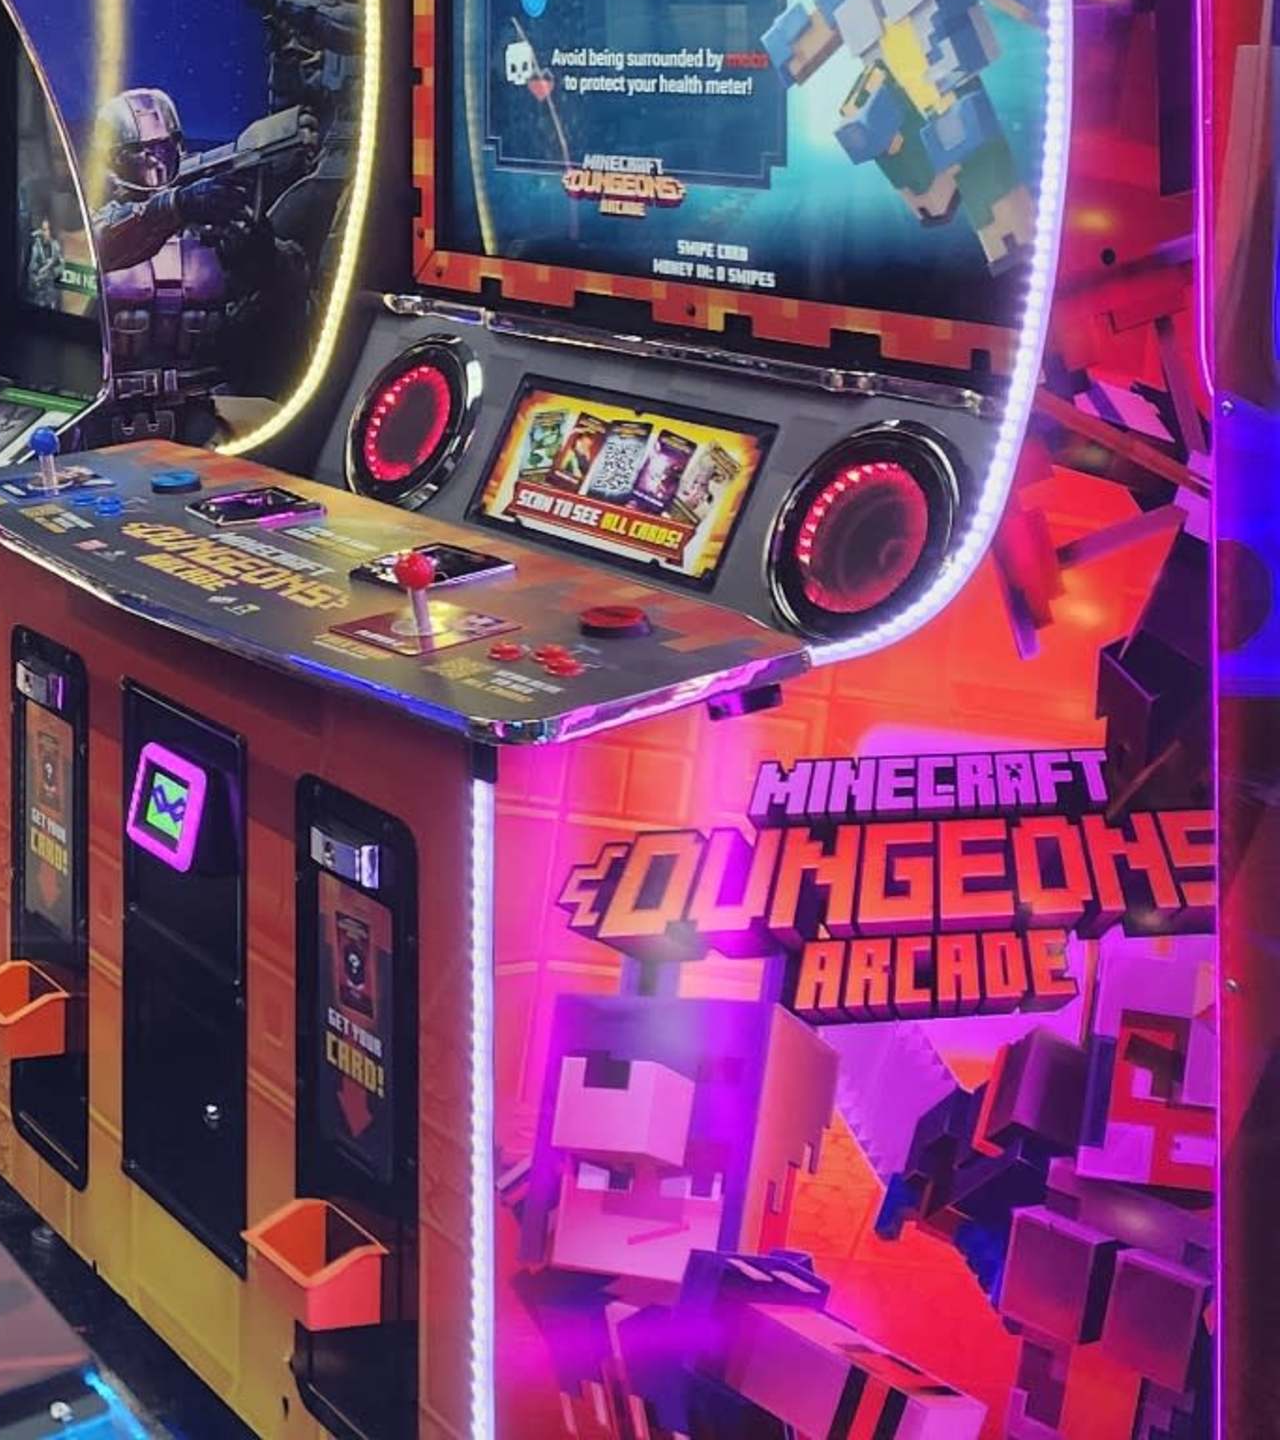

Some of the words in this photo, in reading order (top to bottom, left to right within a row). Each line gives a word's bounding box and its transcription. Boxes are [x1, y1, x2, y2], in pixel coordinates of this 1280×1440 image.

[551, 47, 587, 67] Avoid
[589, 48, 624, 71] being
[627, 48, 703, 69] surrounded
[705, 48, 724, 72] by
[564, 74, 578, 91] to
[580, 74, 626, 94] protect
[627, 78, 658, 96] your
[659, 73, 703, 94] health
[705, 76, 752, 95] meter!
[566, 167, 680, 203] DUNGEONS
[582, 154, 664, 175] MINECRAFT
[652, 258, 694, 278] MONEY
[727, 266, 776, 288] SWIPES
[676, 238, 715, 259] SWIPE
[716, 244, 749, 262] CARD
[516, 489, 550, 513] SCAN
[552, 498, 572, 518] TO
[570, 503, 600, 526] SEE
[600, 511, 629, 536] ALL
[628, 519, 683, 550] CARDS!
[132, 522, 337, 610] DUNGEONS
[208, 532, 337, 577] MINECRAFT
[752, 748, 1109, 816] MINECRAFT
[30, 826, 68, 876] CARD!
[598, 810, 1216, 940] DUNGEONS
[794, 928, 1080, 1016] ARCADE
[327, 1006, 351, 1037] GET
[350, 1021, 383, 1059] YOUR
[325, 1030, 385, 1099] CARD!
